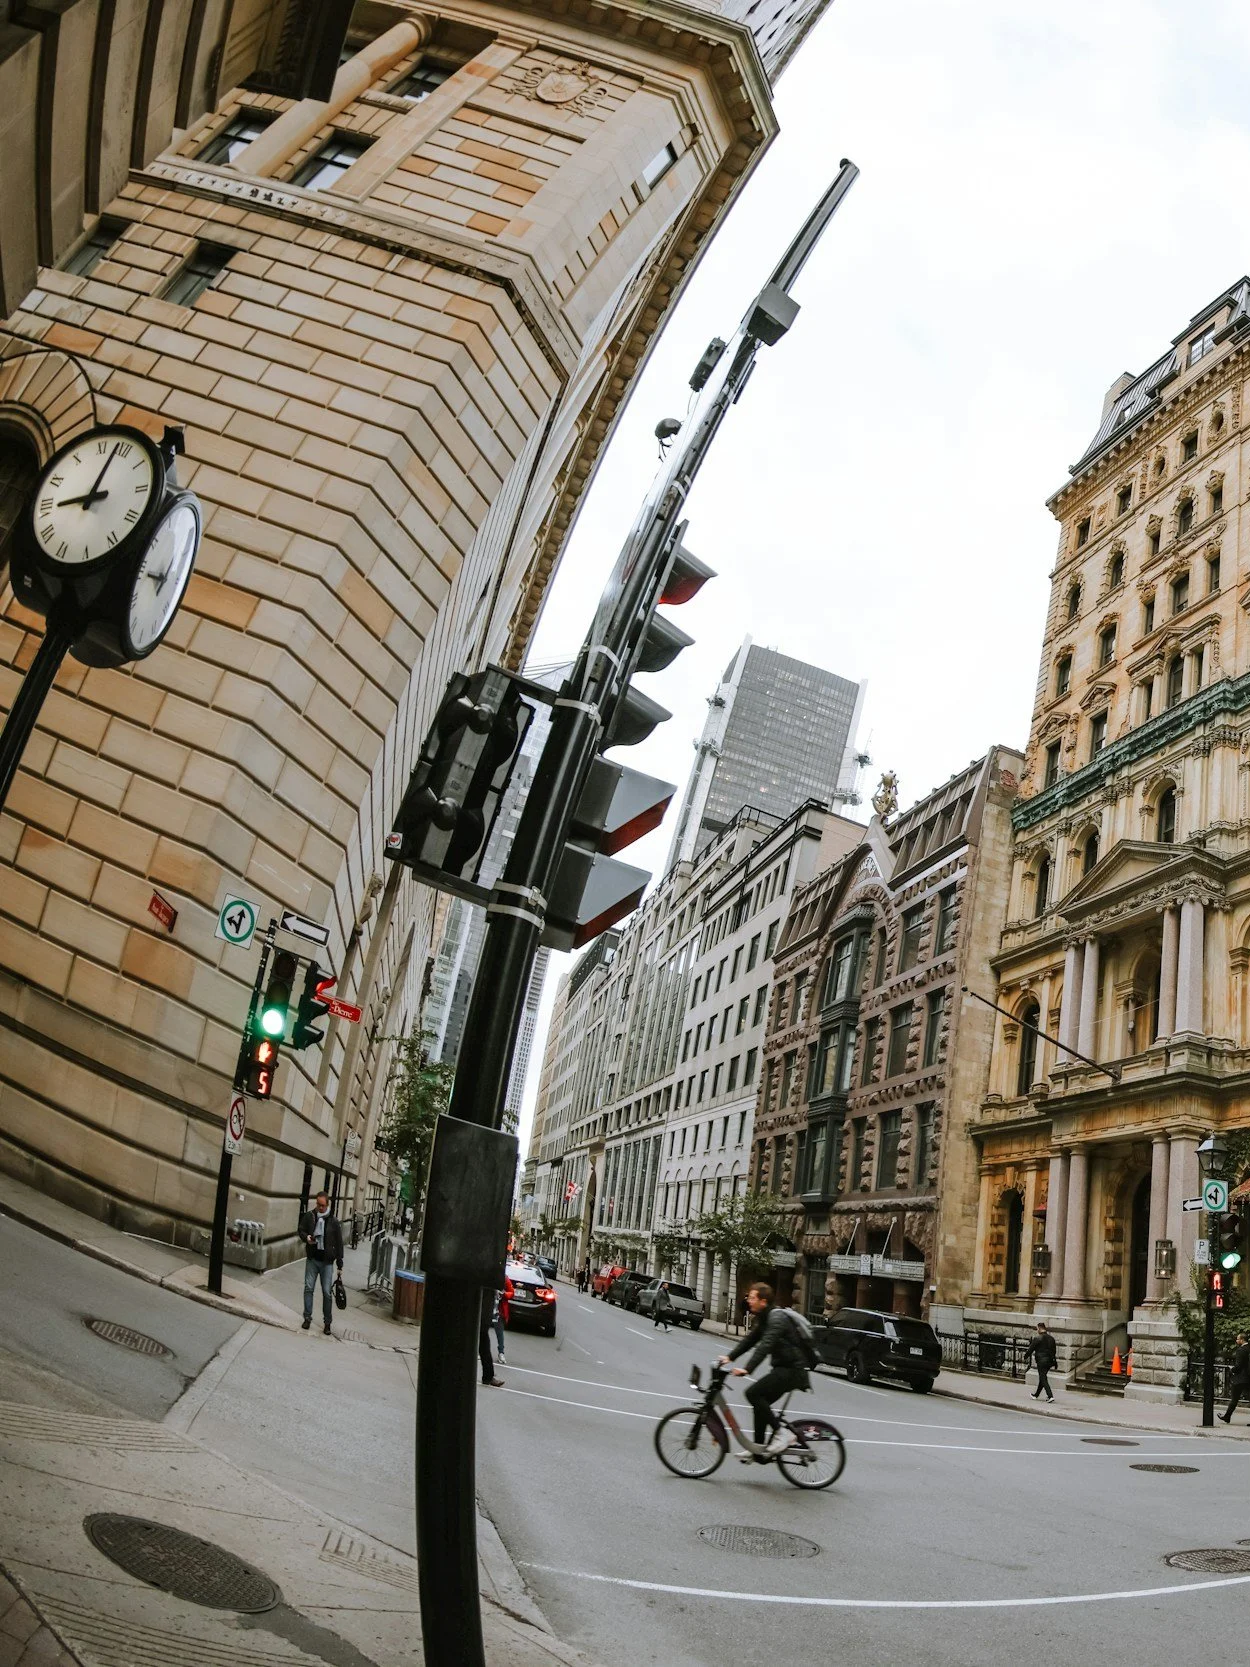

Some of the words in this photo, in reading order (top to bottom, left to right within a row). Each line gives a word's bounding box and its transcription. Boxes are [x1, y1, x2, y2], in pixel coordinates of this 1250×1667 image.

[96, 441, 107, 456] XI
[73, 453, 82, 466] X
[50, 474, 64, 488] IX
[135, 484, 149, 494] II
[40, 498, 54, 518] VIII
[124, 508, 139, 524] III
[257, 1071, 268, 1094] 5
